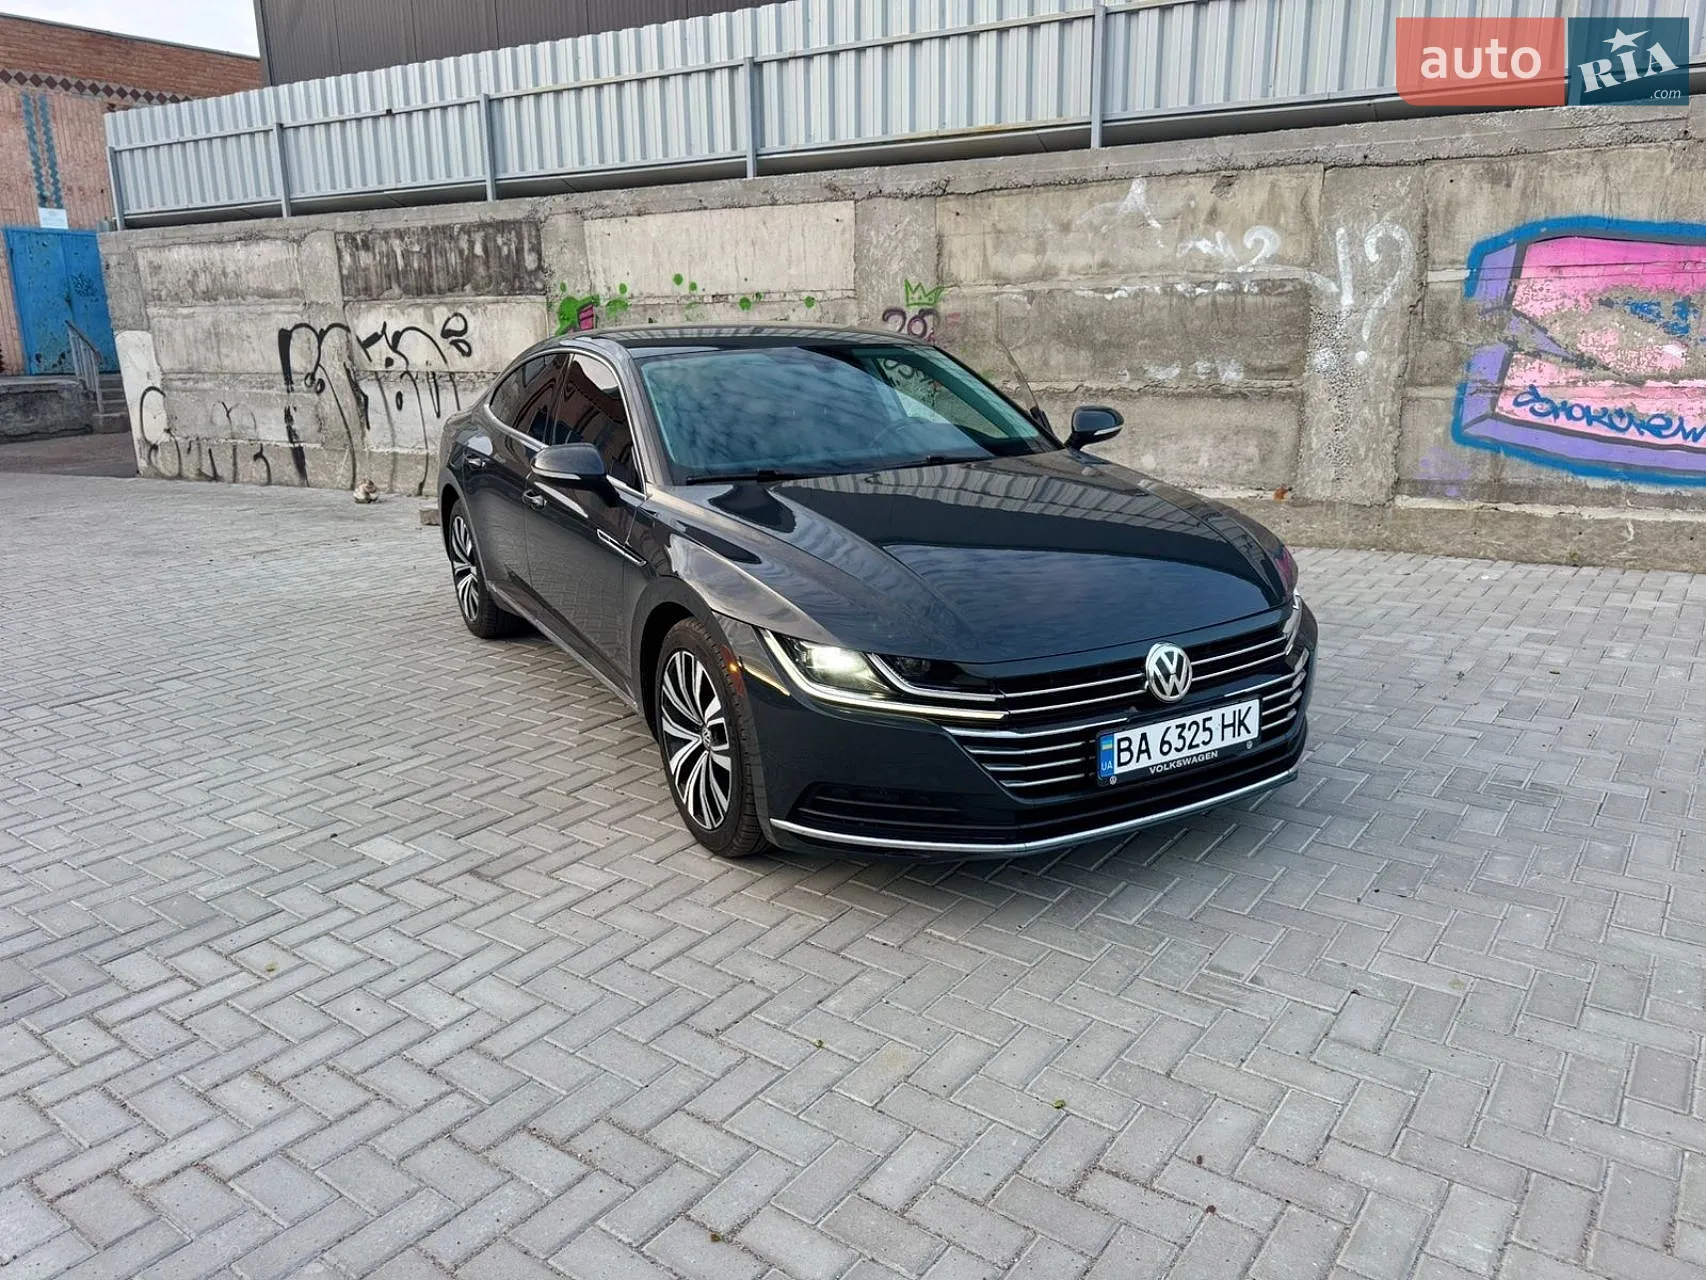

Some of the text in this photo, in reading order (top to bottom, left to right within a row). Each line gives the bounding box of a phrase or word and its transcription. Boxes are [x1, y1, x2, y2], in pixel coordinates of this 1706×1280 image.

[1117, 706, 1252, 767] BA 6325 HK
[1101, 761, 1113, 771] UA
[1149, 750, 1218, 774] VOLKSWAGEN
